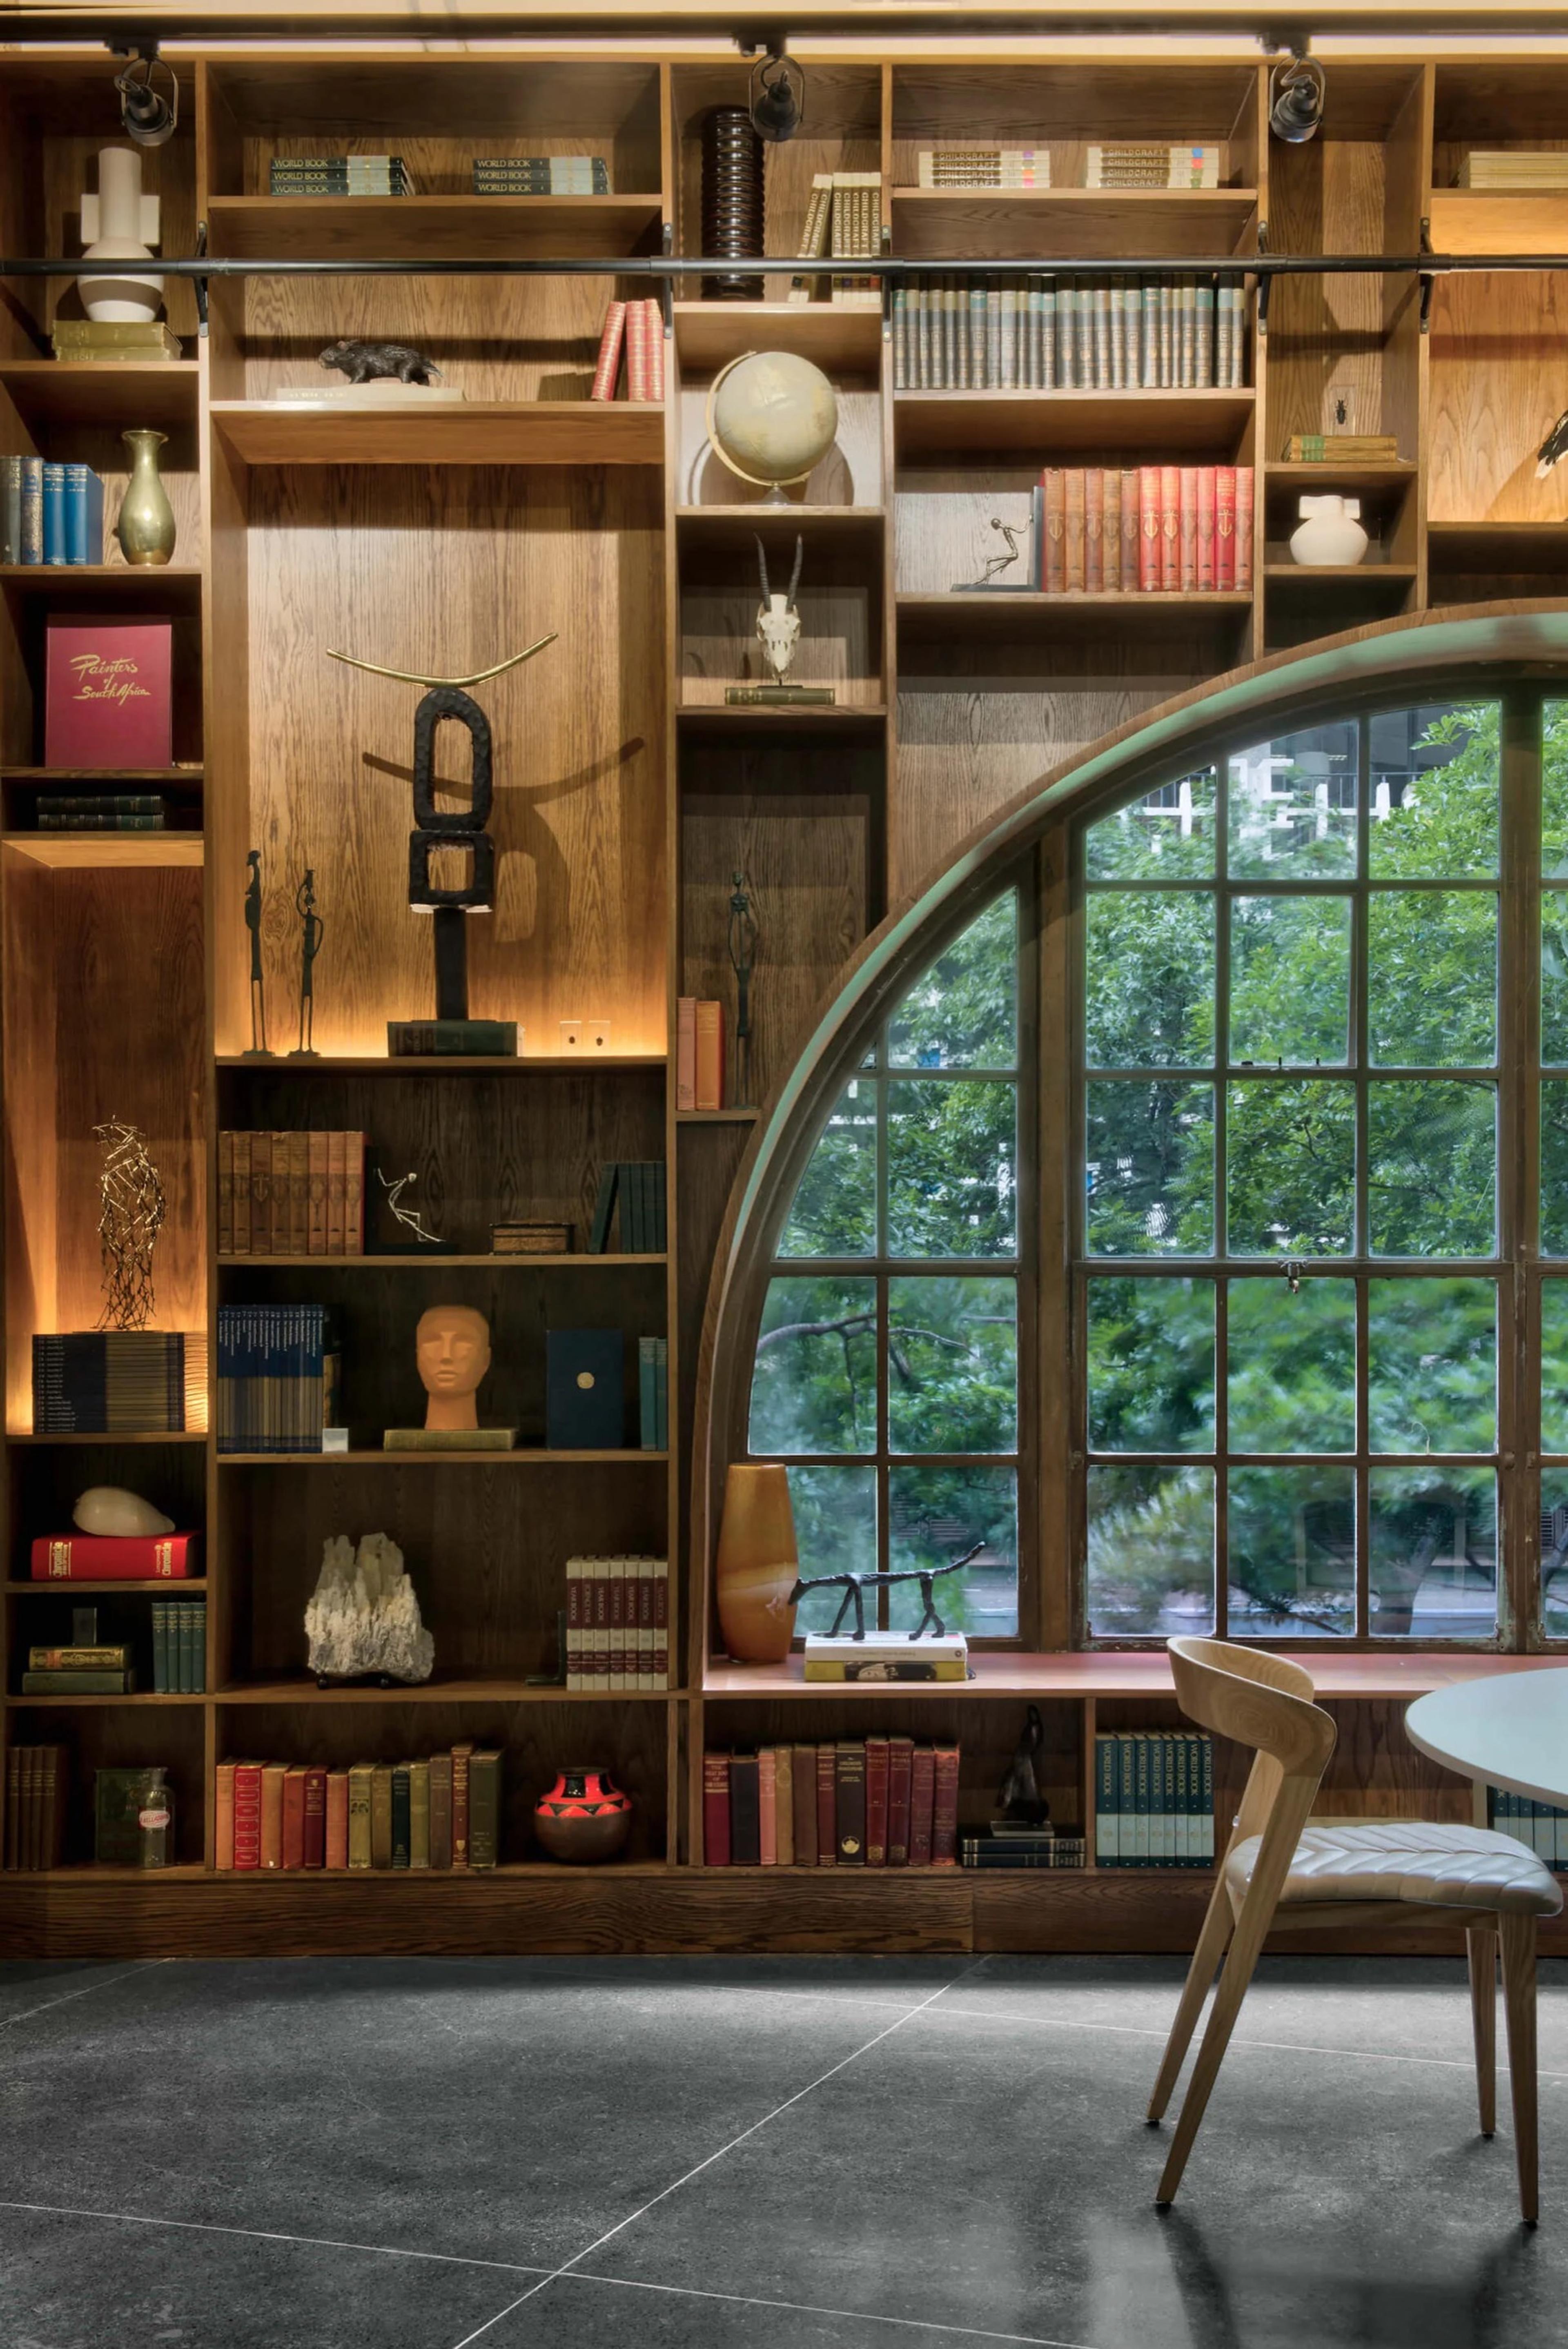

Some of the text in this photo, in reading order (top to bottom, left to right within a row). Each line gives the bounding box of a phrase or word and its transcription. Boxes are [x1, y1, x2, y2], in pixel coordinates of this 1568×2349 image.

[275, 159, 327, 167] WORLD BOOK
[802, 193, 817, 249] CHILDCRAFT
[811, 194, 827, 250] CHILDCRAFT
[70, 654, 138, 681] Painters
[103, 674, 115, 689] of
[72, 682, 152, 706] South Africa
[53, 1542, 63, 1576] Chronicle
[162, 1542, 172, 1576] Chronicle
